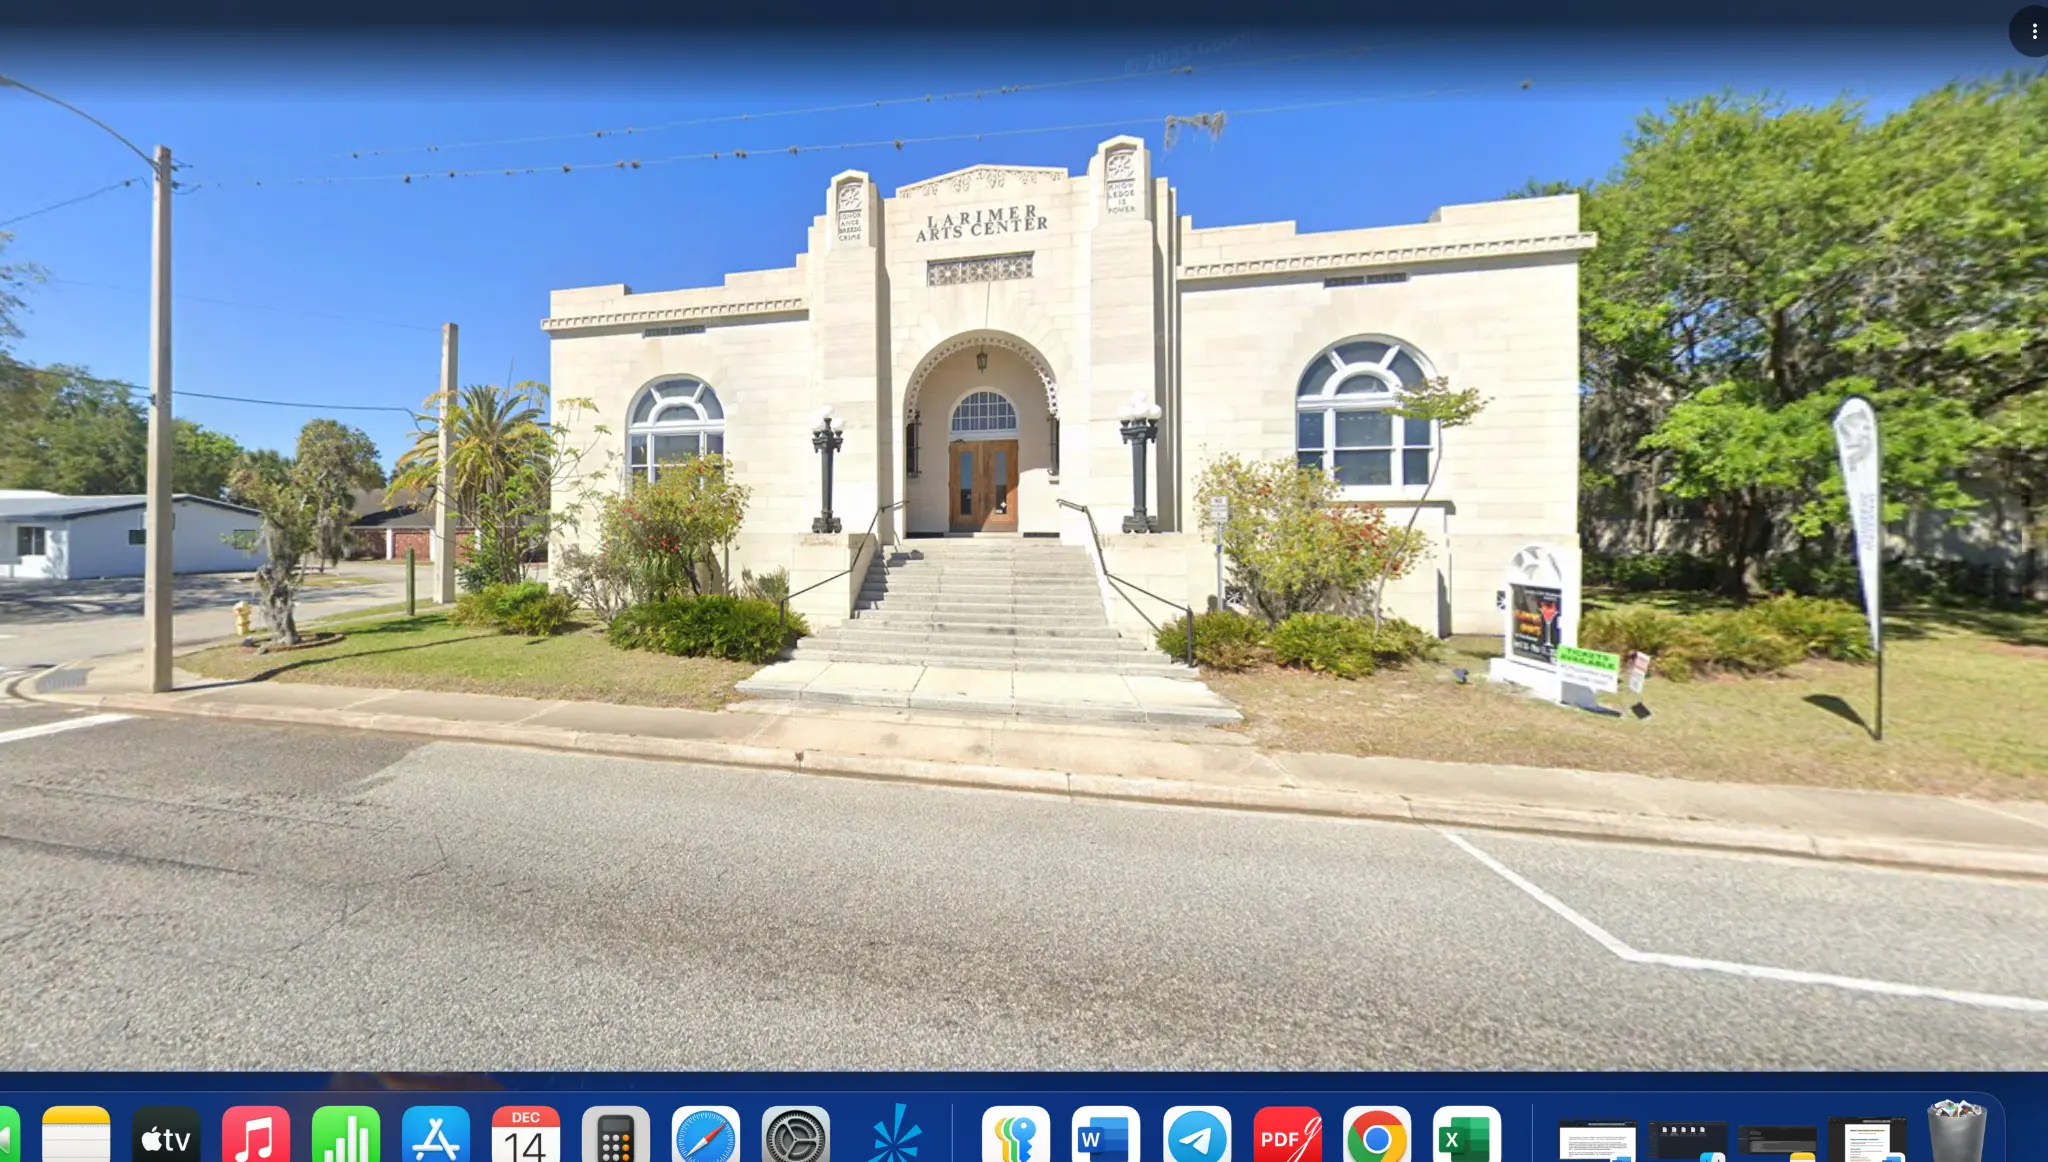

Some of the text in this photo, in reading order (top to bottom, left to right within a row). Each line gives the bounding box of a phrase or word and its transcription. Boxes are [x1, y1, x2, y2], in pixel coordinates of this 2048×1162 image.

[927, 204, 1036, 229] LARIMER
[1108, 205, 1135, 214] POWER
[916, 216, 1048, 243] ARTS CENTER
[1567, 648, 1609, 661] TICKETS
[512, 1112, 541, 1123] DEC
[163, 1129, 191, 1151] tv
[1082, 1132, 1100, 1147] W
[1446, 1132, 1459, 1147] X
[505, 1133, 546, 1162] 14
